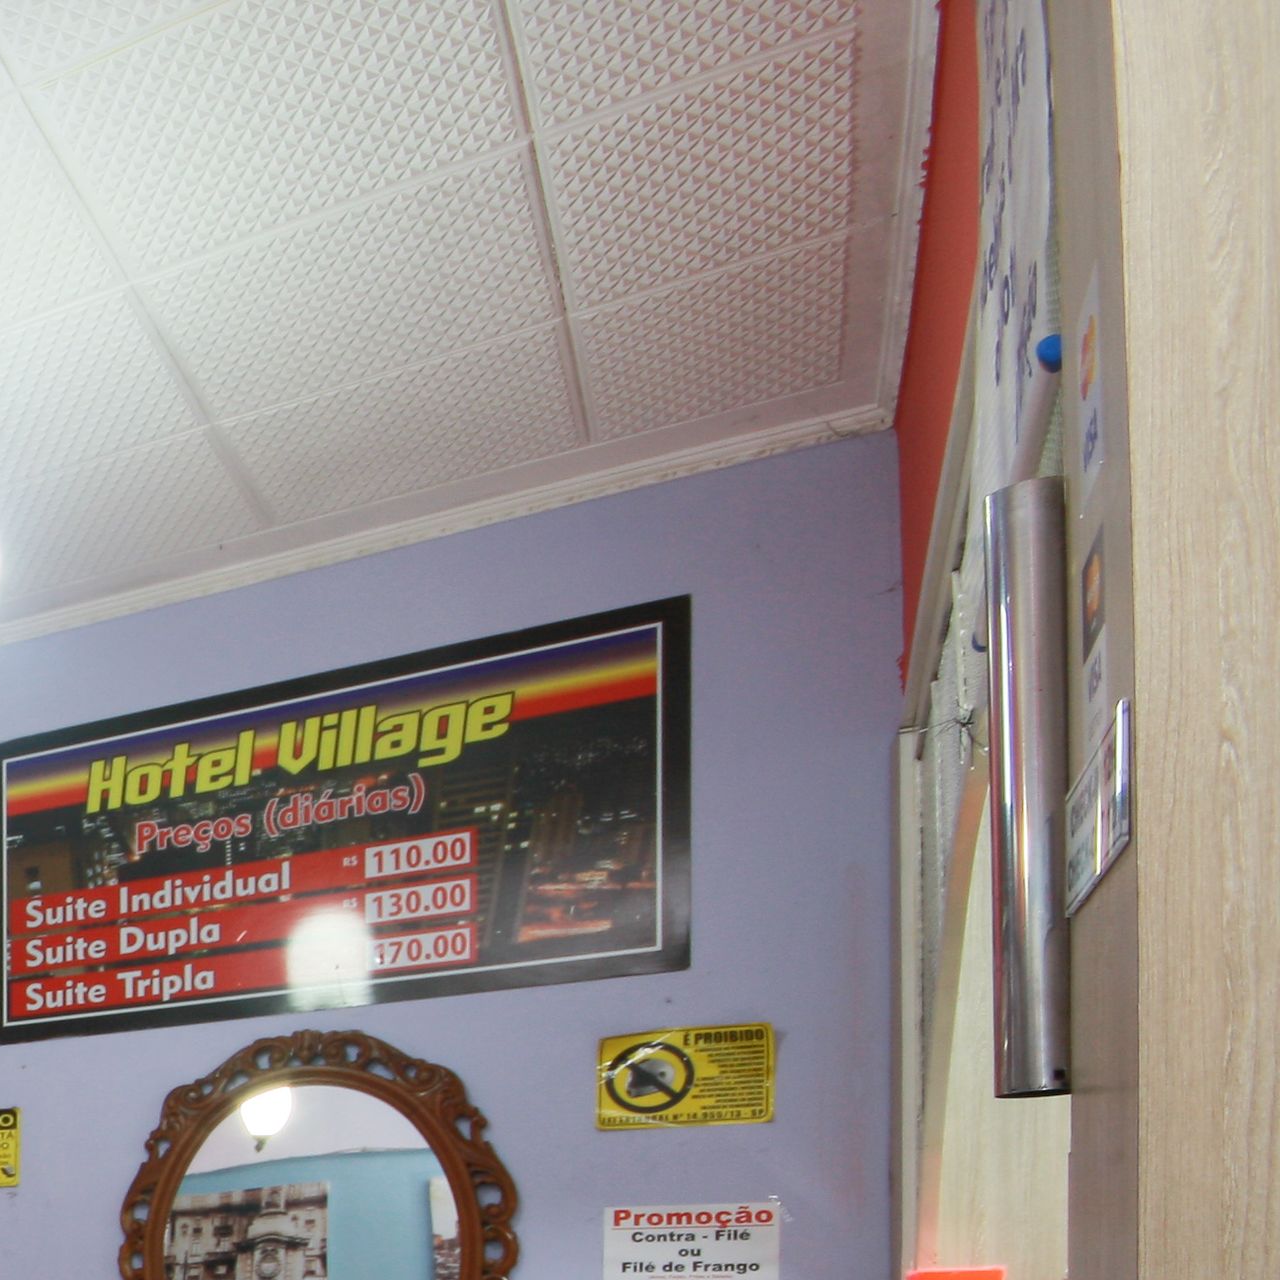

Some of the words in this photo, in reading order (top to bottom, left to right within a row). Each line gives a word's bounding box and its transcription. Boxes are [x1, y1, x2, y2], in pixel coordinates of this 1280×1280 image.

[87, 729, 255, 814] Hotel
[277, 691, 515, 775] Village
[134, 813, 251, 852] Preços
[264, 773, 426, 838] (diárias)
[26, 900, 107, 928] Suite
[120, 862, 291, 914] Individual
[372, 837, 467, 873] 110.00
[25, 939, 107, 968] Suite
[120, 918, 222, 959] Dupla
[372, 882, 468, 919] 130.00
[25, 982, 107, 1012] Suite
[117, 964, 216, 1002] Tripla
[376, 931, 468, 966] 170.00
[694, 1028, 765, 1045] PROIBIDO
[613, 1206, 774, 1229] Promoção
[631, 1231, 696, 1243] Contra
[715, 1229, 751, 1241] Filé
[621, 1261, 656, 1273] Filé
[662, 1261, 685, 1272] de
[692, 1260, 760, 1275] Frango
[678, 1248, 702, 1257] ou
